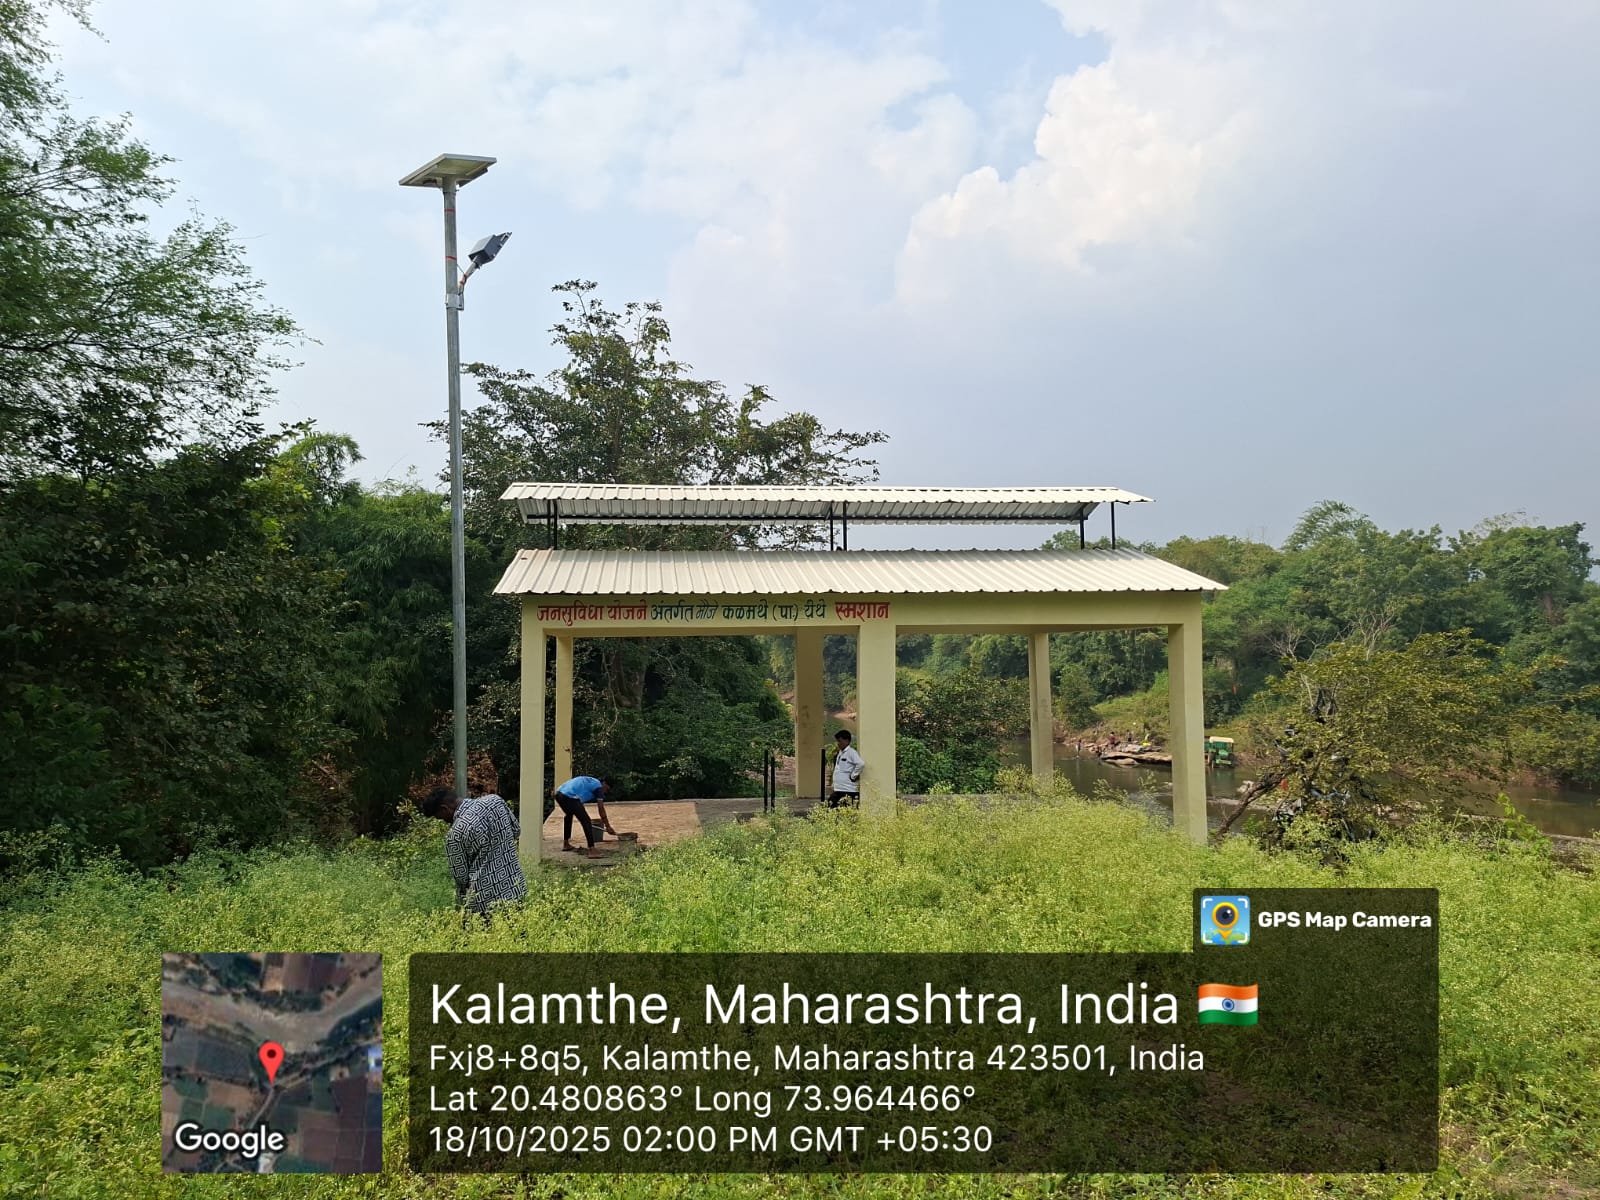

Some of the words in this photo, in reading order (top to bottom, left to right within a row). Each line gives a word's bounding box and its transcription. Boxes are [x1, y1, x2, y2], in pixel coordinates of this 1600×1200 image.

[537, 600, 604, 626] जनसुविधा
[607, 599, 648, 620] योजने
[651, 599, 694, 623] अंतर्गत
[721, 599, 768, 620] कळमथे
[804, 599, 827, 619] येथे
[835, 602, 890, 622] स्मशान
